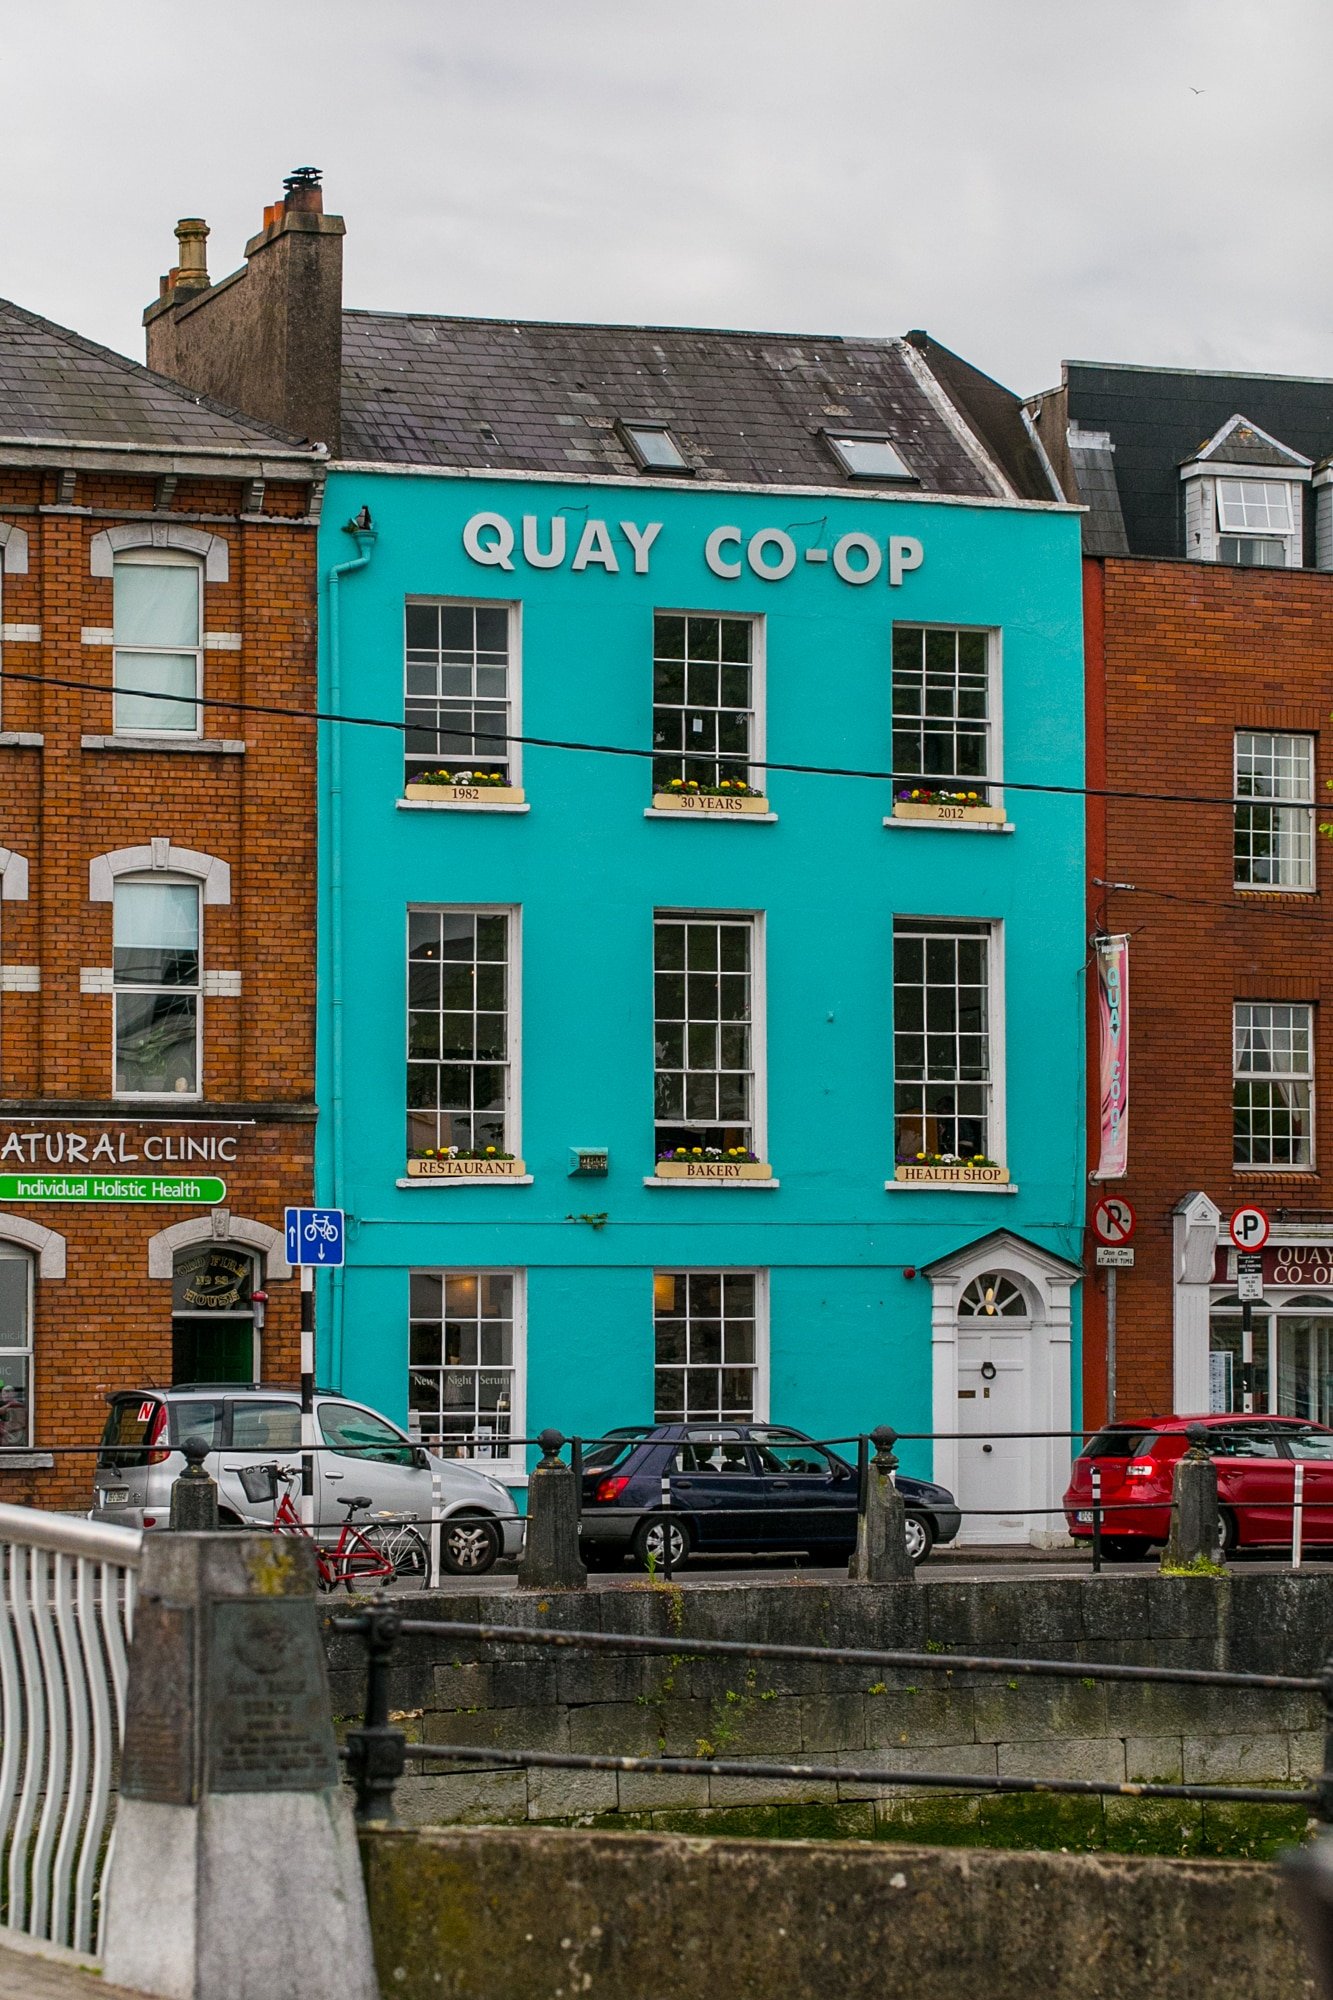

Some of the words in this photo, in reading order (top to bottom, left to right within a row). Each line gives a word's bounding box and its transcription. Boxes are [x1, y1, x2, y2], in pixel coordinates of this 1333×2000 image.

[462, 511, 664, 574] QUAY
[704, 525, 925, 586] CO-OP
[452, 787, 480, 800] 1982
[681, 797, 695, 808] 30
[698, 797, 743, 810] YEARS
[938, 807, 964, 819] 2012
[1107, 966, 1121, 1048] QUAY
[143, 1136, 237, 1162] CLINIC
[419, 1161, 516, 1175] RESTAURANT
[687, 1164, 742, 1177] BAKERY
[905, 1168, 960, 1180] HEALTH
[963, 1169, 1002, 1181] SHOP
[17, 1179, 88, 1197] Individual
[93, 1180, 147, 1198] Holistic
[151, 1181, 201, 1198] Health
[1243, 1215, 1259, 1240] P
[183, 1288, 240, 1307] HOUSE
[414, 1376, 434, 1385] New
[448, 1375, 472, 1388] Night
[480, 1375, 509, 1385] Serum
[140, 1403, 153, 1419] N
